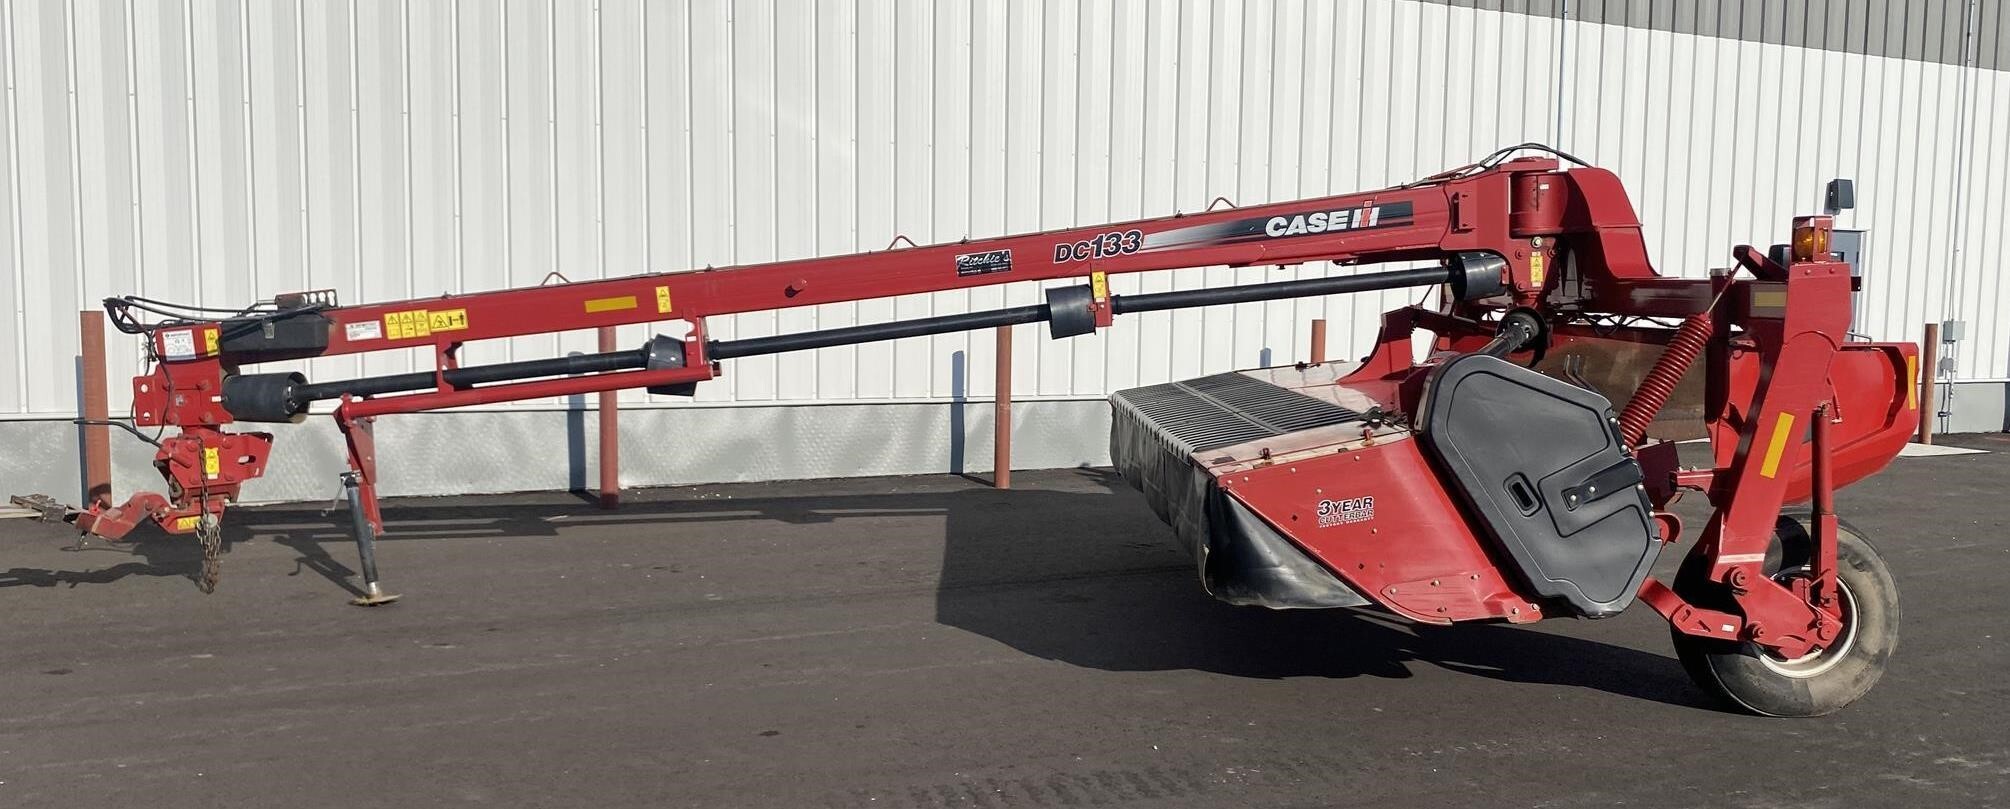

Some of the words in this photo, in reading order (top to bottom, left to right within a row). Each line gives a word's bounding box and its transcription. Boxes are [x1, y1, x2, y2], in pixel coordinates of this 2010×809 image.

[1265, 211, 1349, 237] CASE
[1053, 229, 1142, 264] DC133
[957, 251, 1010, 267] Ritchie's
[1319, 509, 1374, 524] CUTTERBAR
